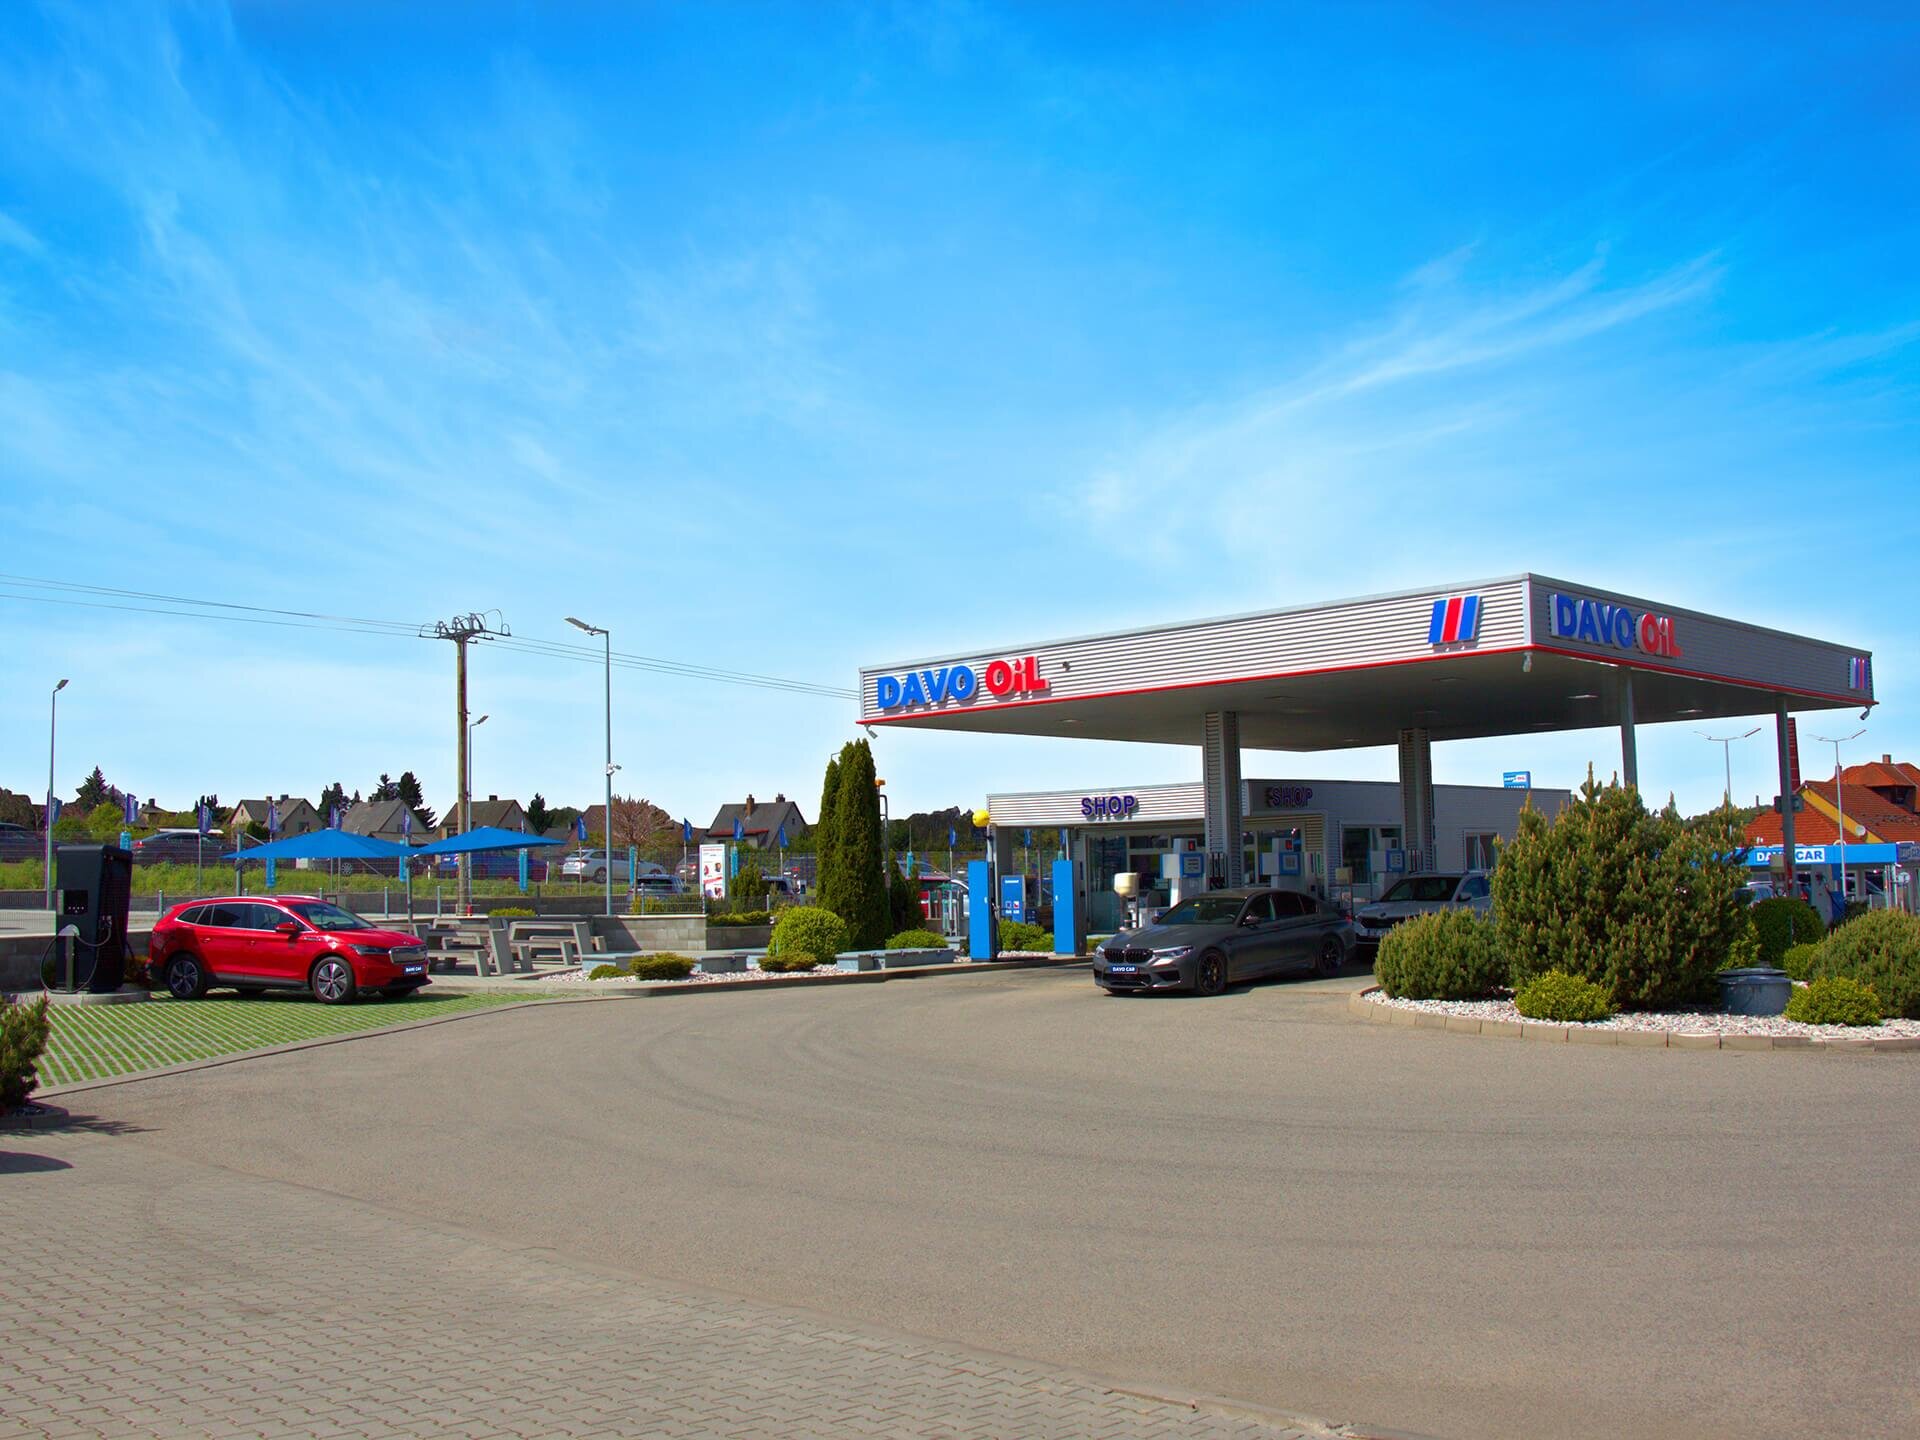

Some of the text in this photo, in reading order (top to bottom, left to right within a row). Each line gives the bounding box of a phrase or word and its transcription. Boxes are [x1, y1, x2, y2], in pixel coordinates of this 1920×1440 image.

[1552, 594, 1634, 649] DAVO
[877, 665, 976, 708] DAVO
[1081, 795, 1135, 816] SHOP
[1271, 786, 1313, 806] SHOP
[1795, 850, 1822, 860] CAR
